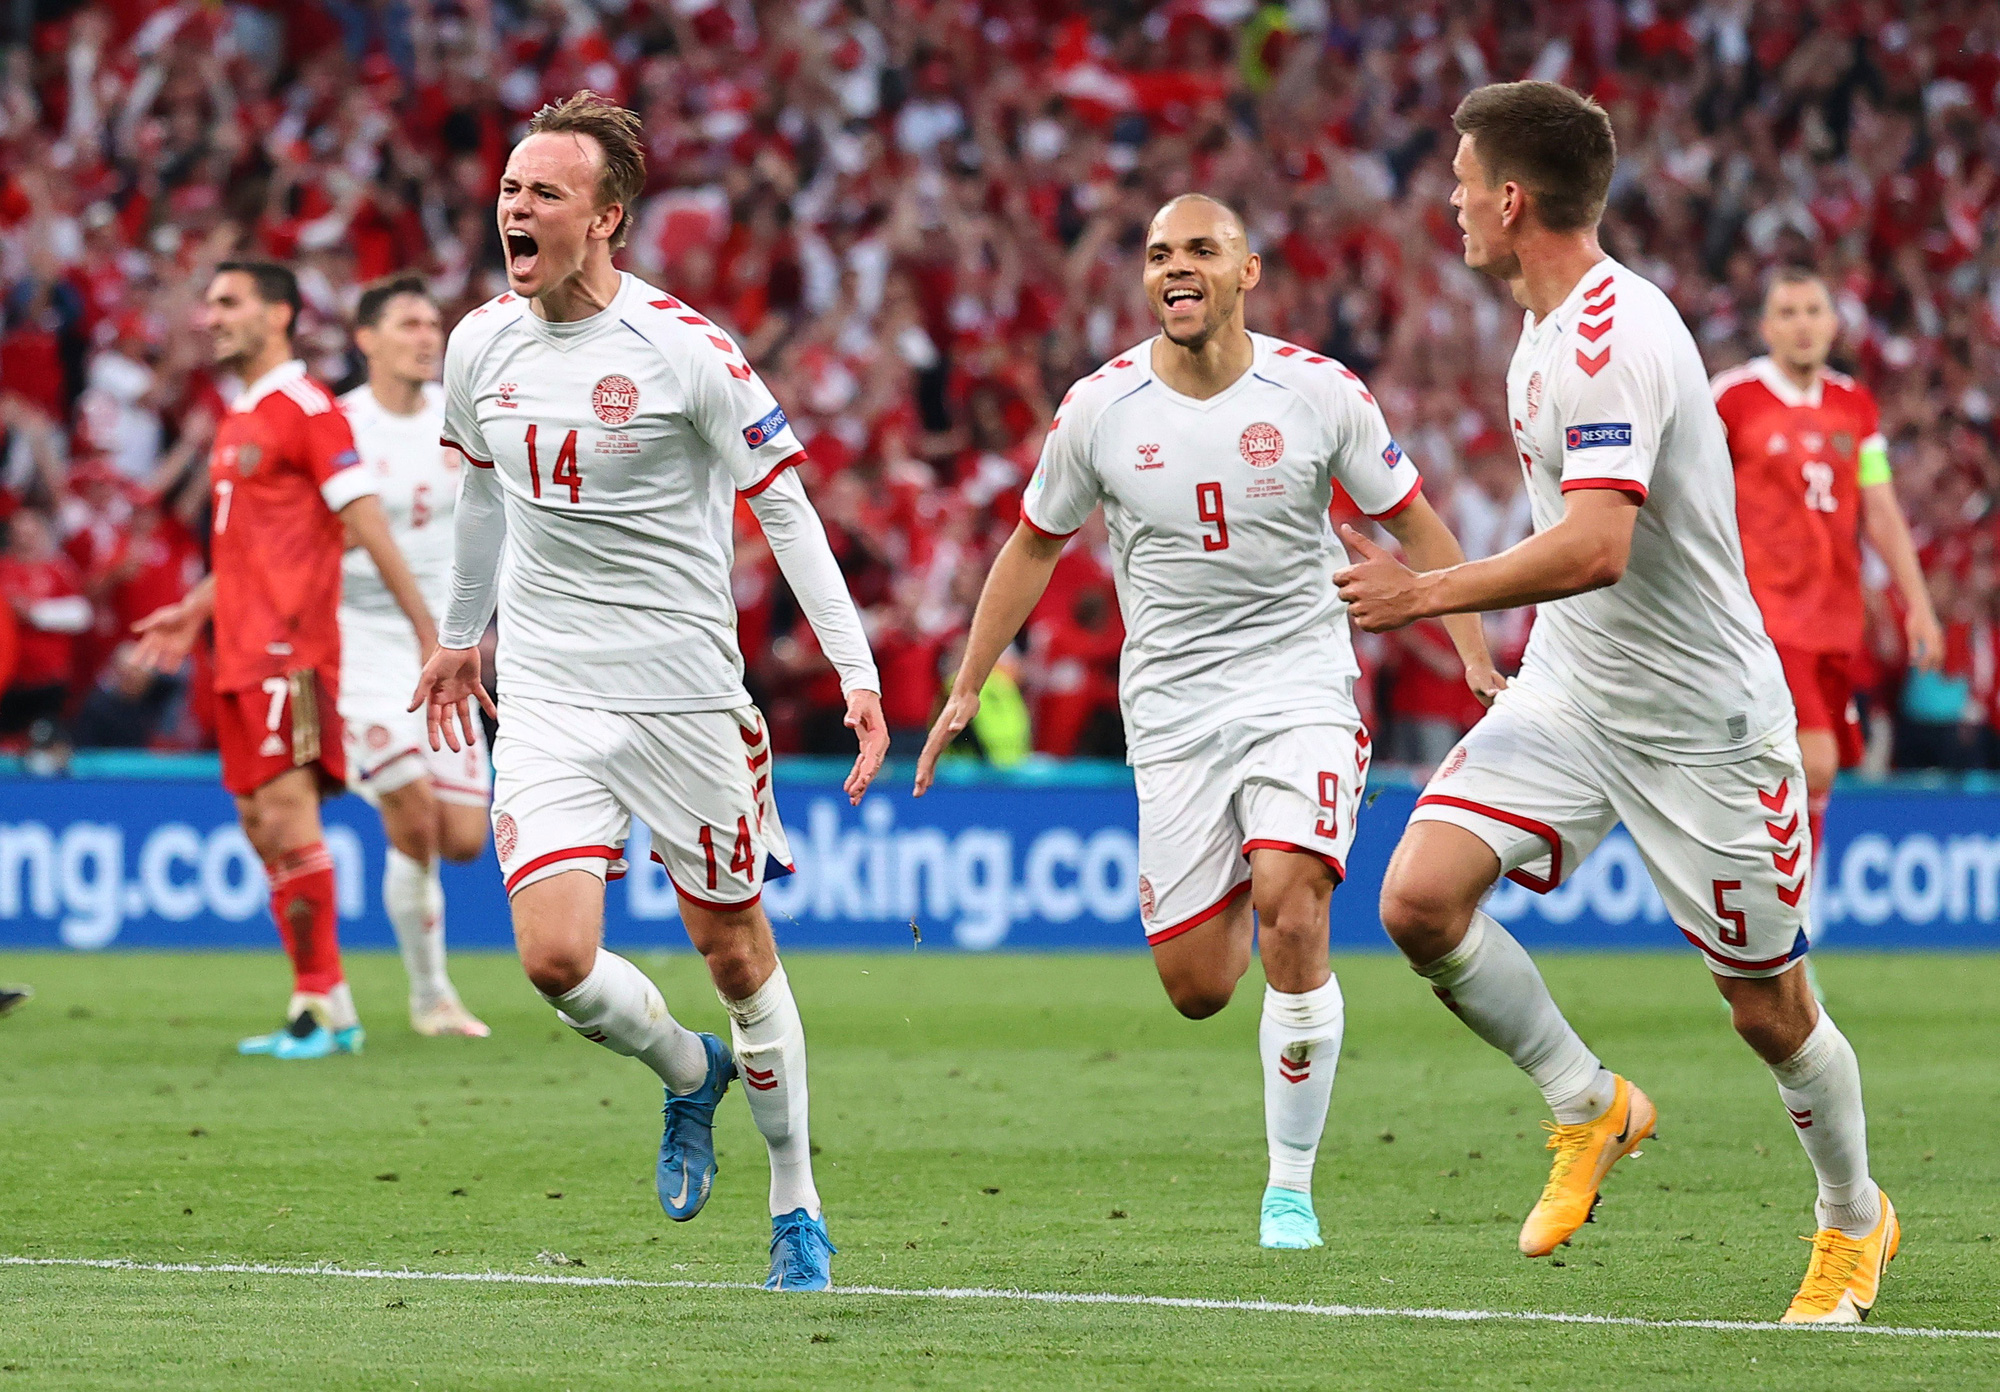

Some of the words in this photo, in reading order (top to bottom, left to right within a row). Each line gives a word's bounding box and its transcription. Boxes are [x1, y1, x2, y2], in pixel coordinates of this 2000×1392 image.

[601, 391, 631, 408] DBU
[524, 424, 582, 504] 14
[1248, 437, 1275, 452] DBU
[1581, 429, 1631, 442] RESPECT
[1196, 482, 1229, 552] 9
[1801, 460, 1838, 513] 22
[262, 677, 289, 732] 7
[1315, 771, 1338, 839] 9
[698, 815, 755, 890] 14
[1712, 879, 1747, 947] 5
